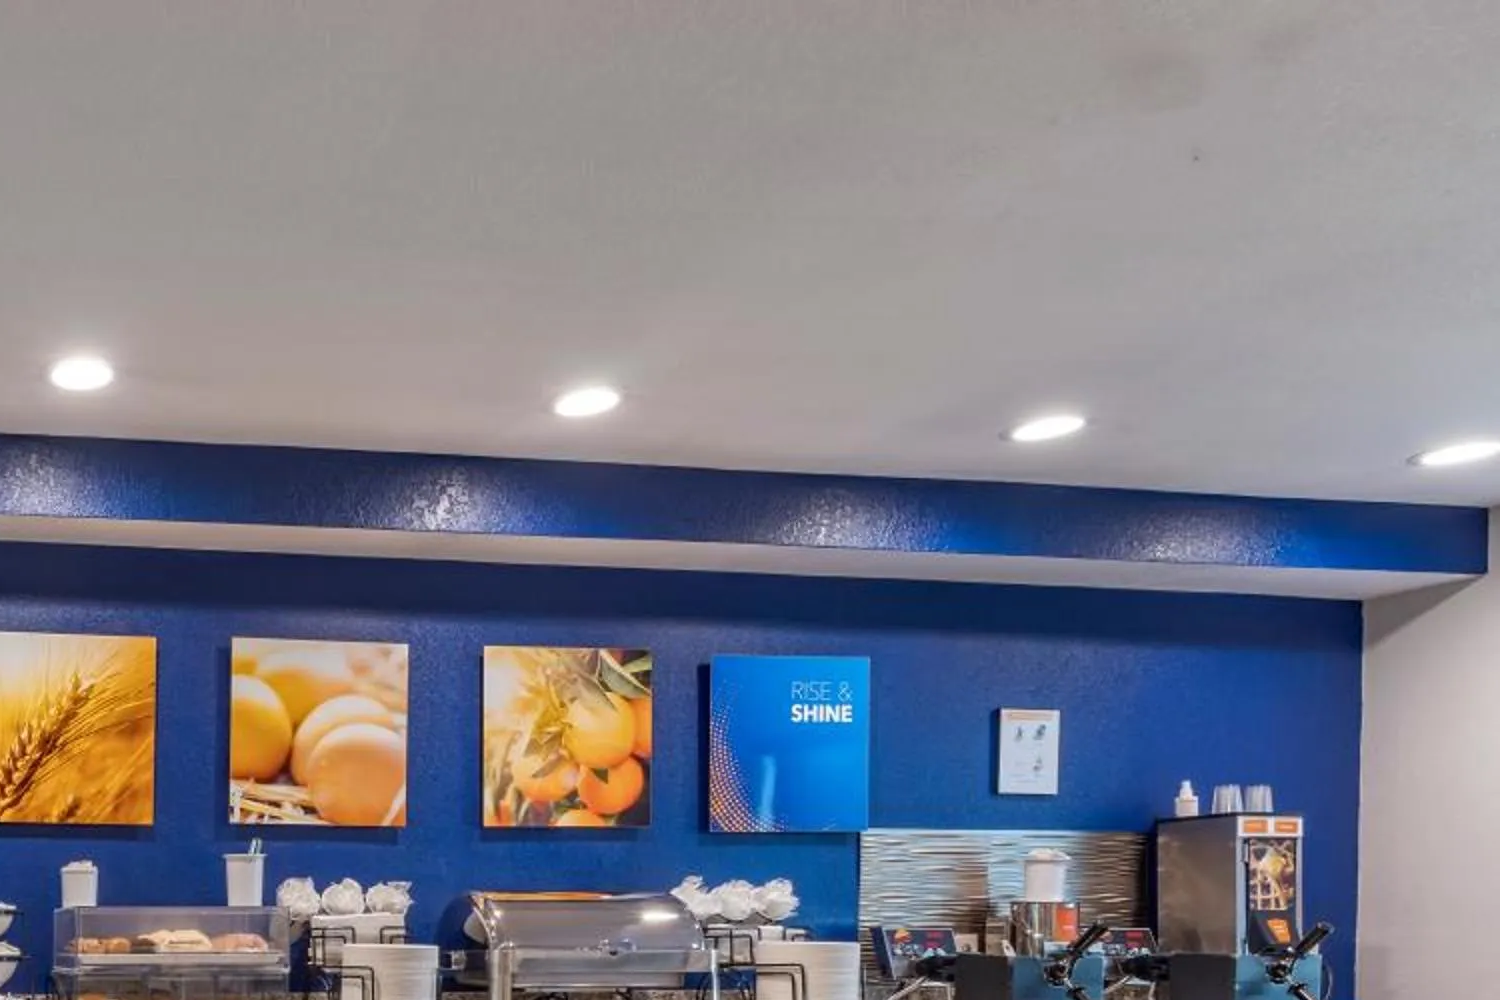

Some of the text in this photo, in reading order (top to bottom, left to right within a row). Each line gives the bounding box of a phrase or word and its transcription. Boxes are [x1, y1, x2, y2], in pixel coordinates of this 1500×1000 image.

[791, 681, 854, 701] RISE &
[790, 703, 853, 723] SHINE
